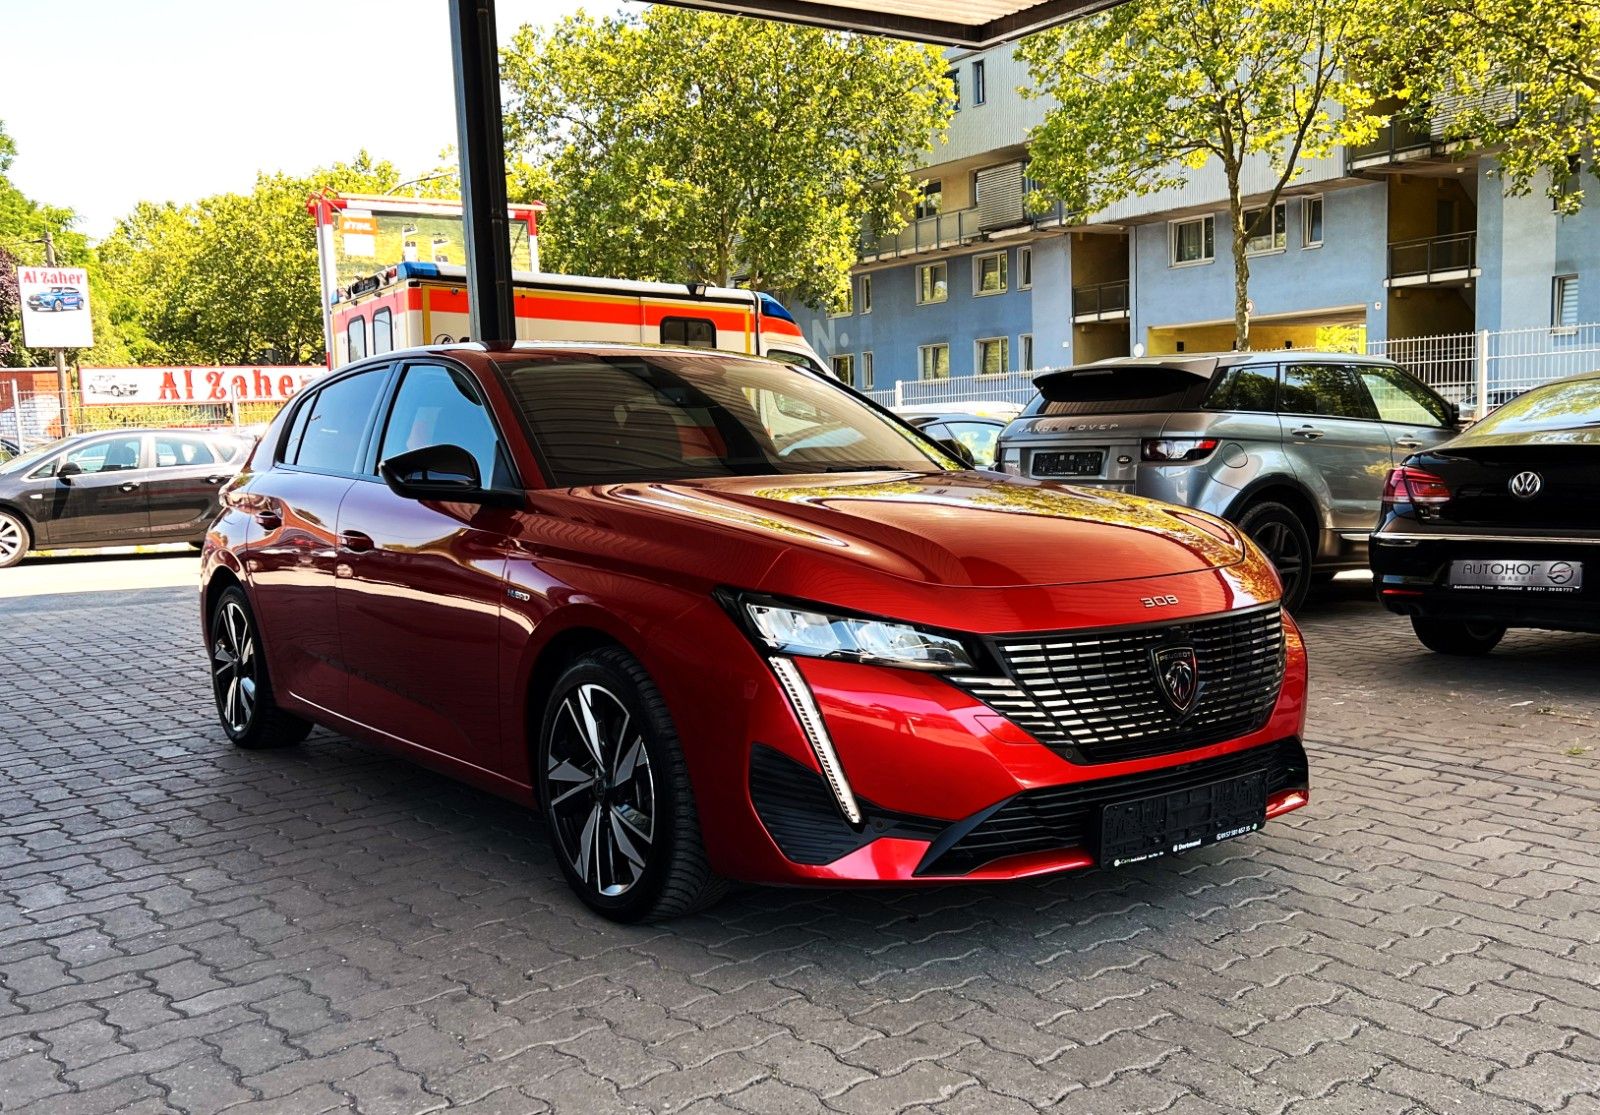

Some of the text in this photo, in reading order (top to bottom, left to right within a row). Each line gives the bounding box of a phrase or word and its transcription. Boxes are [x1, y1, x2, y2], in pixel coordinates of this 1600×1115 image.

[24, 271, 83, 284] Al Zaher
[159, 369, 194, 400] Al
[1463, 563, 1540, 575] AUTOHOF
[1141, 594, 1179, 608] 308
